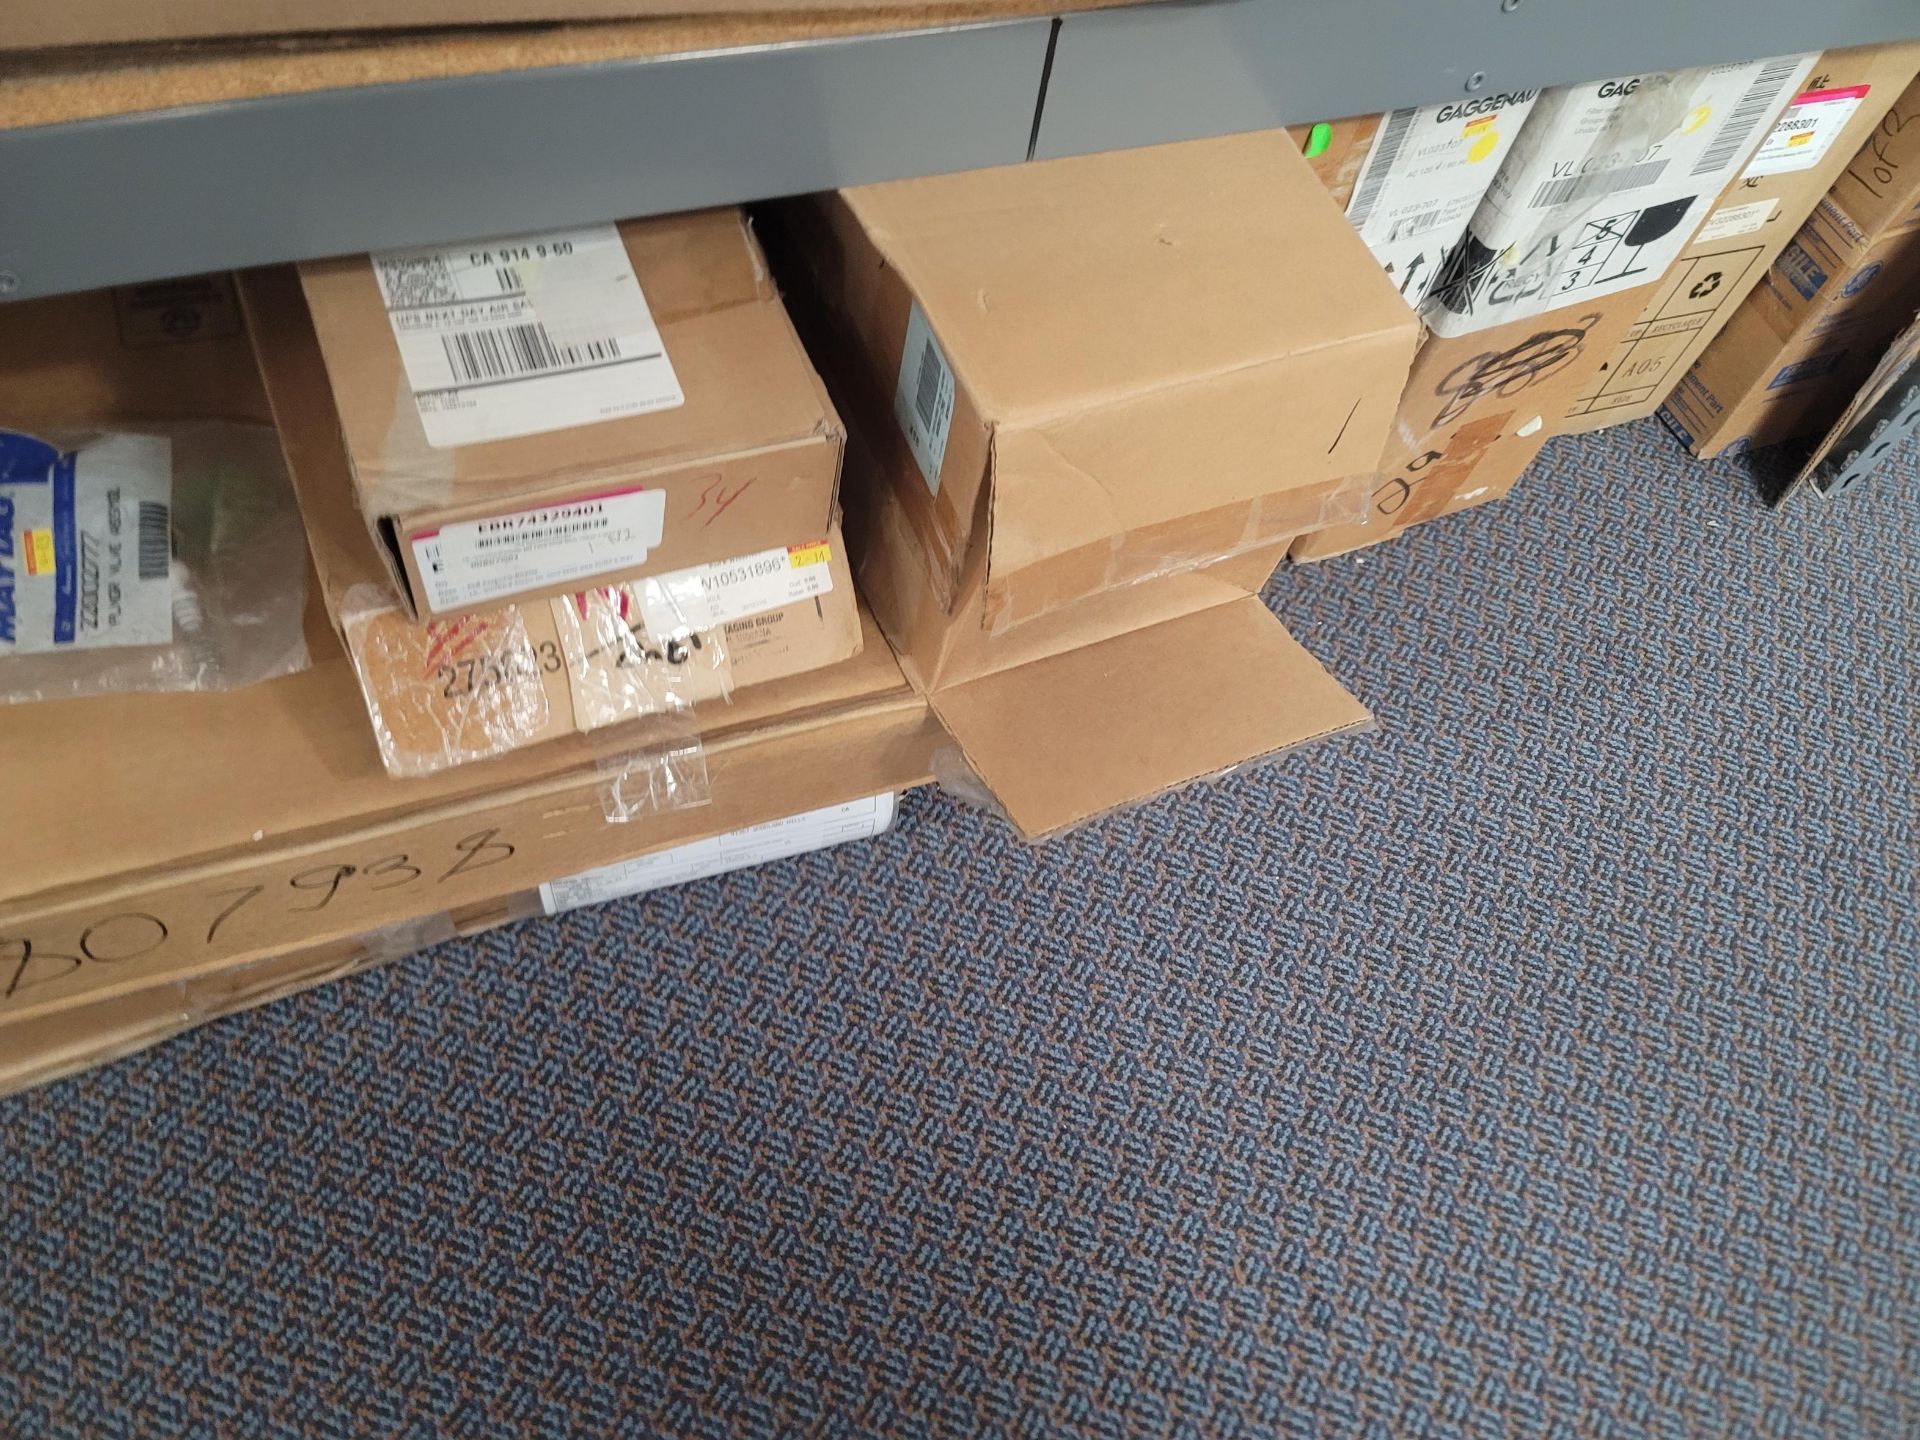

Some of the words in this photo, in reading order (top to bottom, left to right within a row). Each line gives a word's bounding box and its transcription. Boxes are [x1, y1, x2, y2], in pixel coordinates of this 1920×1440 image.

[1436, 89, 1539, 123] GAGGENAU
[1883, 108, 1920, 136] 2
[1873, 133, 1898, 184] of
[1552, 160, 1573, 178] VL
[470, 251, 494, 268] CA
[1578, 245, 1597, 265] 4
[1562, 271, 1581, 290] 3
[462, 306, 484, 318] DAY
[1622, 356, 1666, 378] A05
[1707, 394, 1724, 413] Part
[756, 612, 784, 627] GROUP
